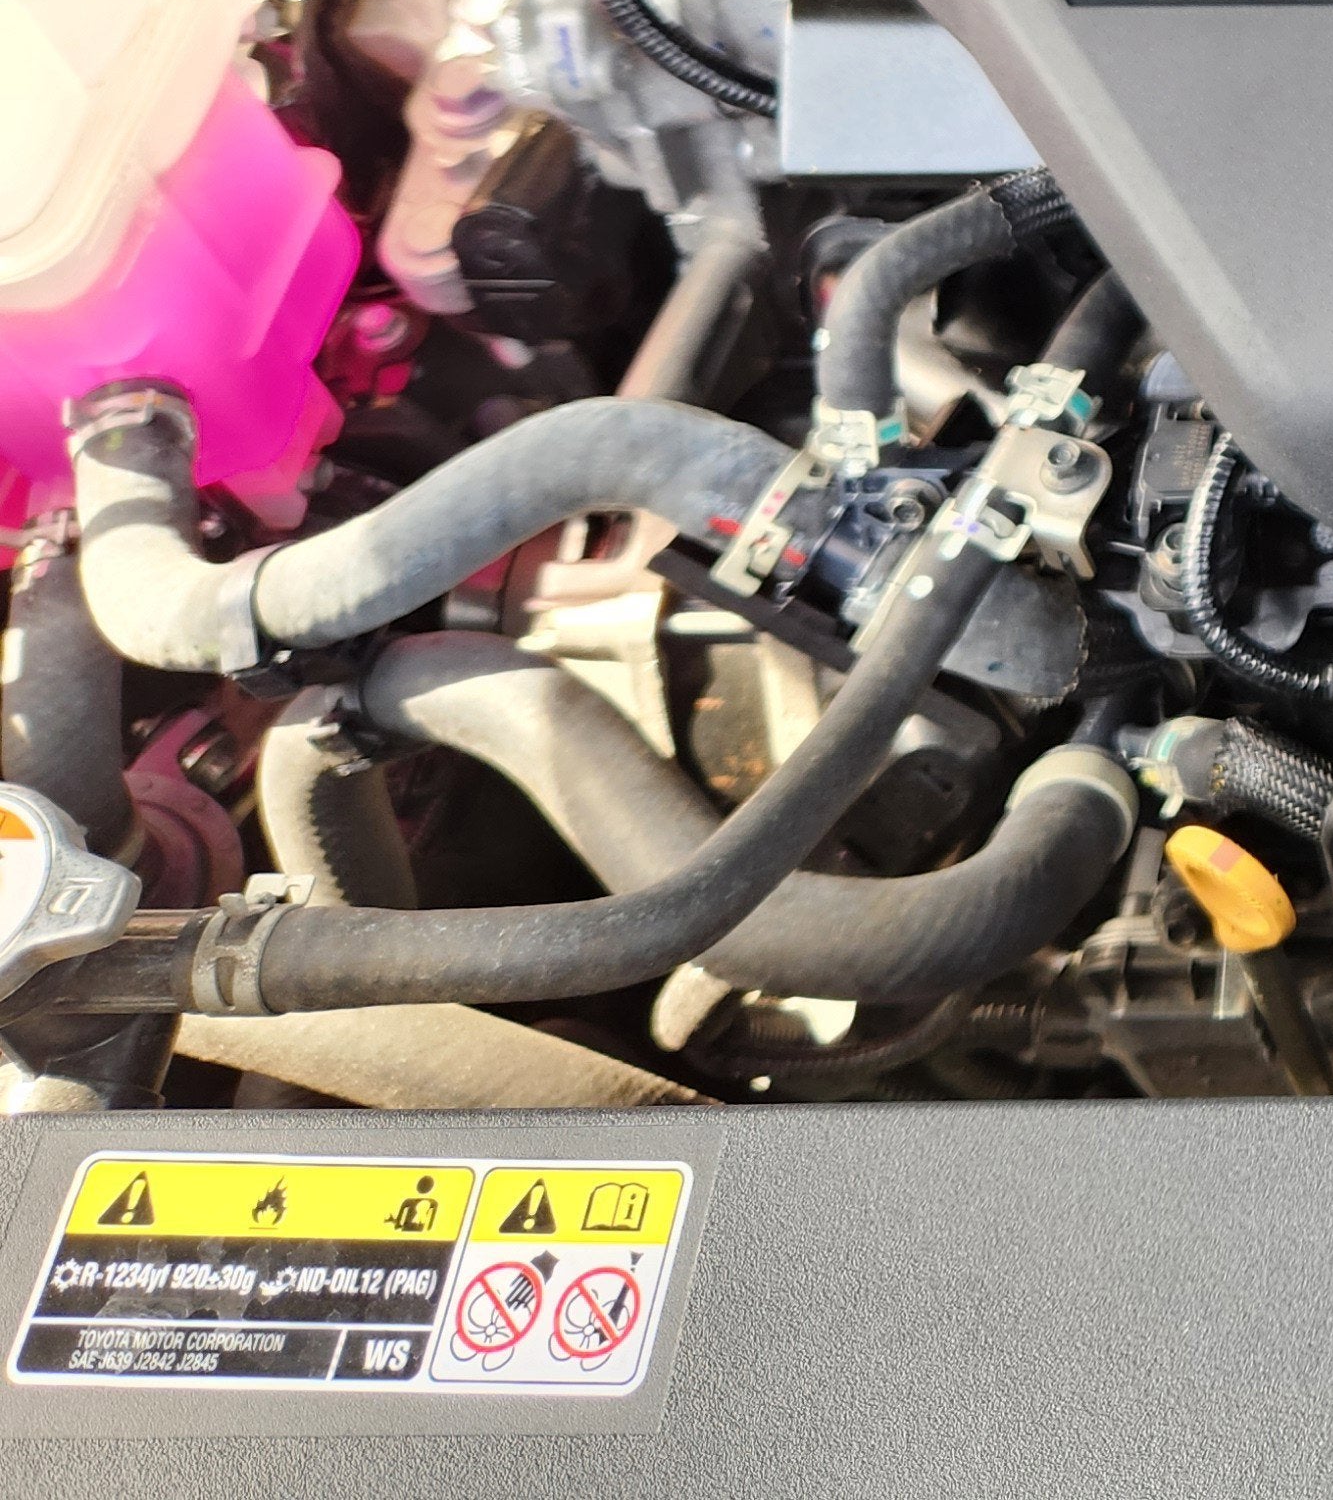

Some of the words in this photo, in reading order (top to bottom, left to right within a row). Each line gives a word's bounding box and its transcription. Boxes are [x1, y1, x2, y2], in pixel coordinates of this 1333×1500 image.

[78, 1261, 172, 1294] R-1234yf
[170, 1263, 258, 1296] 920±30g
[384, 1268, 438, 1300] (PAG)
[77, 1329, 131, 1348] TOYOTA
[131, 1331, 185, 1350] MOTOR
[186, 1332, 286, 1352] CORPORATION
[68, 1350, 98, 1369] SAE
[97, 1351, 134, 1370] J639
[133, 1352, 177, 1371] J2842
[176, 1352, 220, 1372] J2845
[362, 1338, 412, 1372] WS
